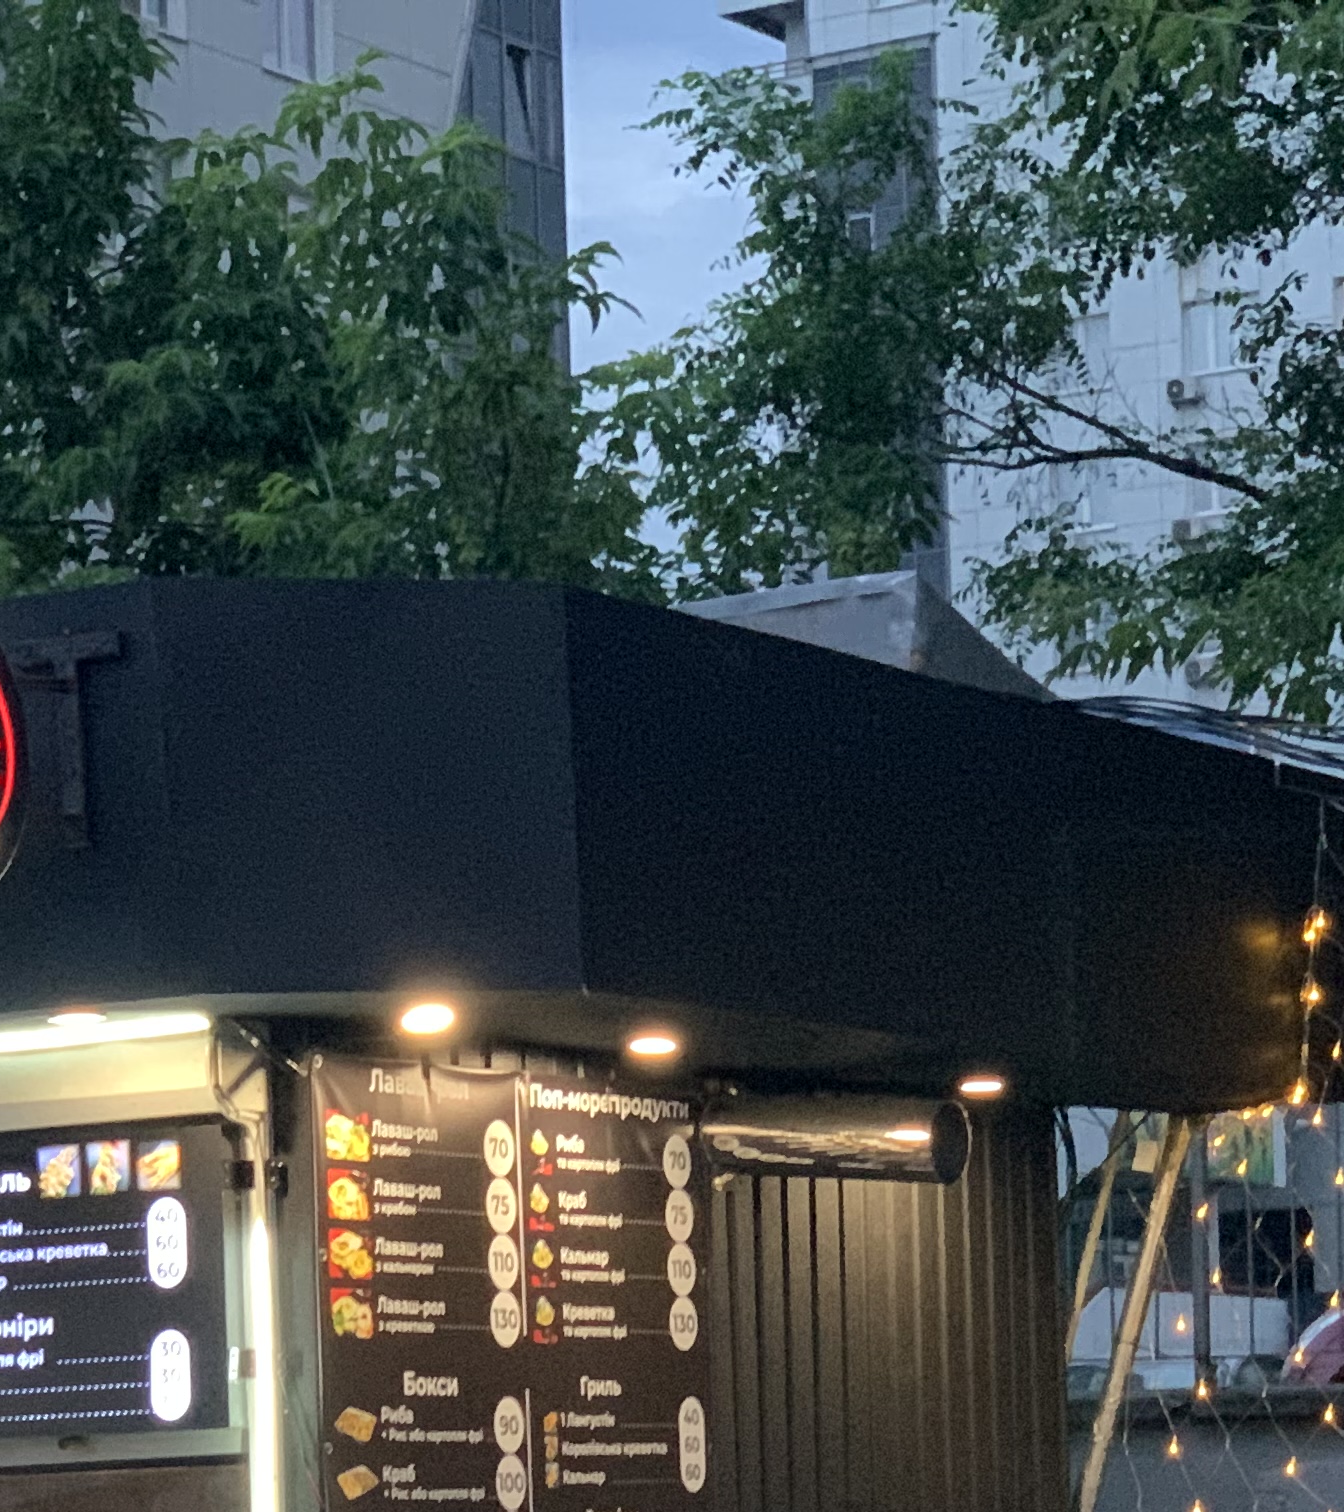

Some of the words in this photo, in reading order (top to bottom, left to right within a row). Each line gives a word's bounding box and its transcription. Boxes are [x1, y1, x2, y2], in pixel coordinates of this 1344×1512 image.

[529, 1083, 689, 1122] Поп-морепродукти
[371, 1118, 438, 1144] Лаваш-рол
[488, 1138, 508, 1158] 70
[668, 1152, 685, 1170] 70
[373, 1178, 442, 1203] Лаваш-рол
[491, 1196, 510, 1216] 75
[558, 1190, 587, 1212] Краб
[671, 1206, 687, 1224] 75
[374, 1236, 444, 1260] Лаваш-рол
[492, 1253, 514, 1273] 110
[671, 1260, 692, 1279] 110
[377, 1294, 446, 1319] Лаваш-рол
[493, 1308, 517, 1328] 130
[673, 1314, 695, 1333] 130
[17, 1348, 44, 1369] фрі
[160, 1341, 182, 1356] 30
[403, 1370, 459, 1396] Бокси
[580, 1375, 622, 1400] Гриль
[499, 1416, 518, 1436] 90
[498, 1473, 524, 1493] 100
